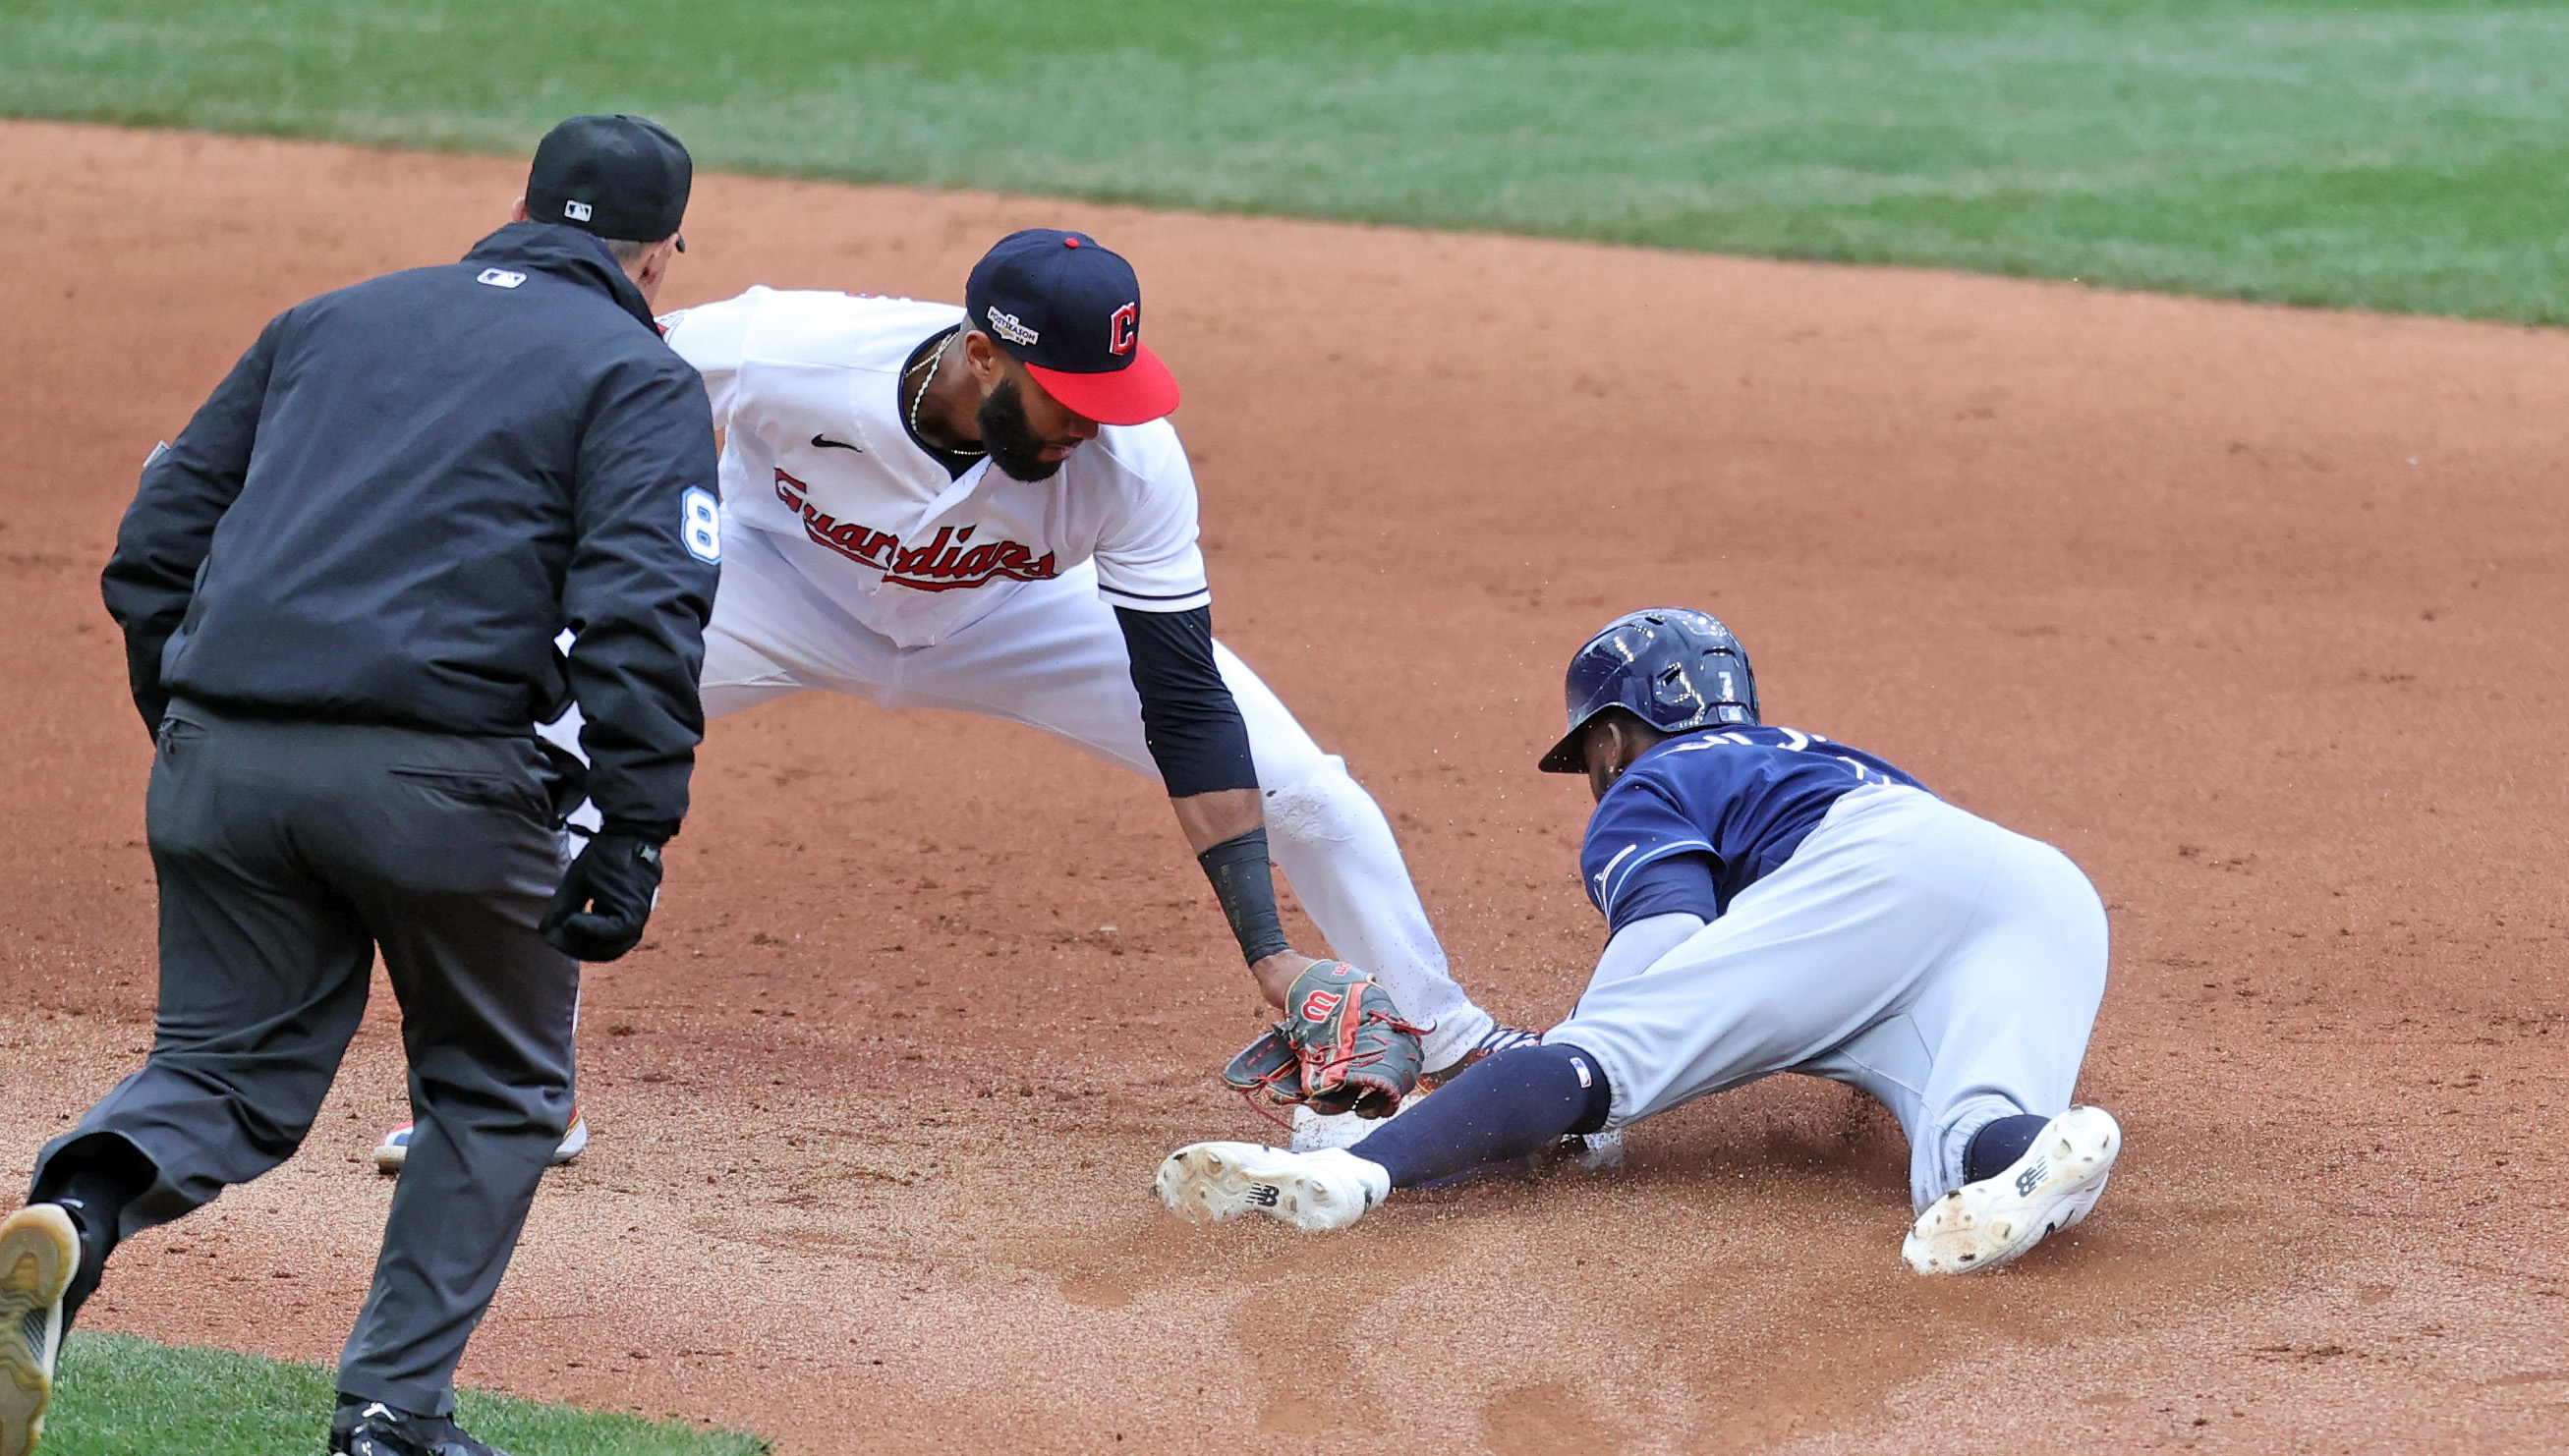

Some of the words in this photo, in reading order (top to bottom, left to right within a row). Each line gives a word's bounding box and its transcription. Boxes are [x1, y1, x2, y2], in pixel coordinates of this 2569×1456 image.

[1110, 303, 1136, 356] C
[680, 485, 721, 566] 8
[774, 467, 1058, 586] Guardians
